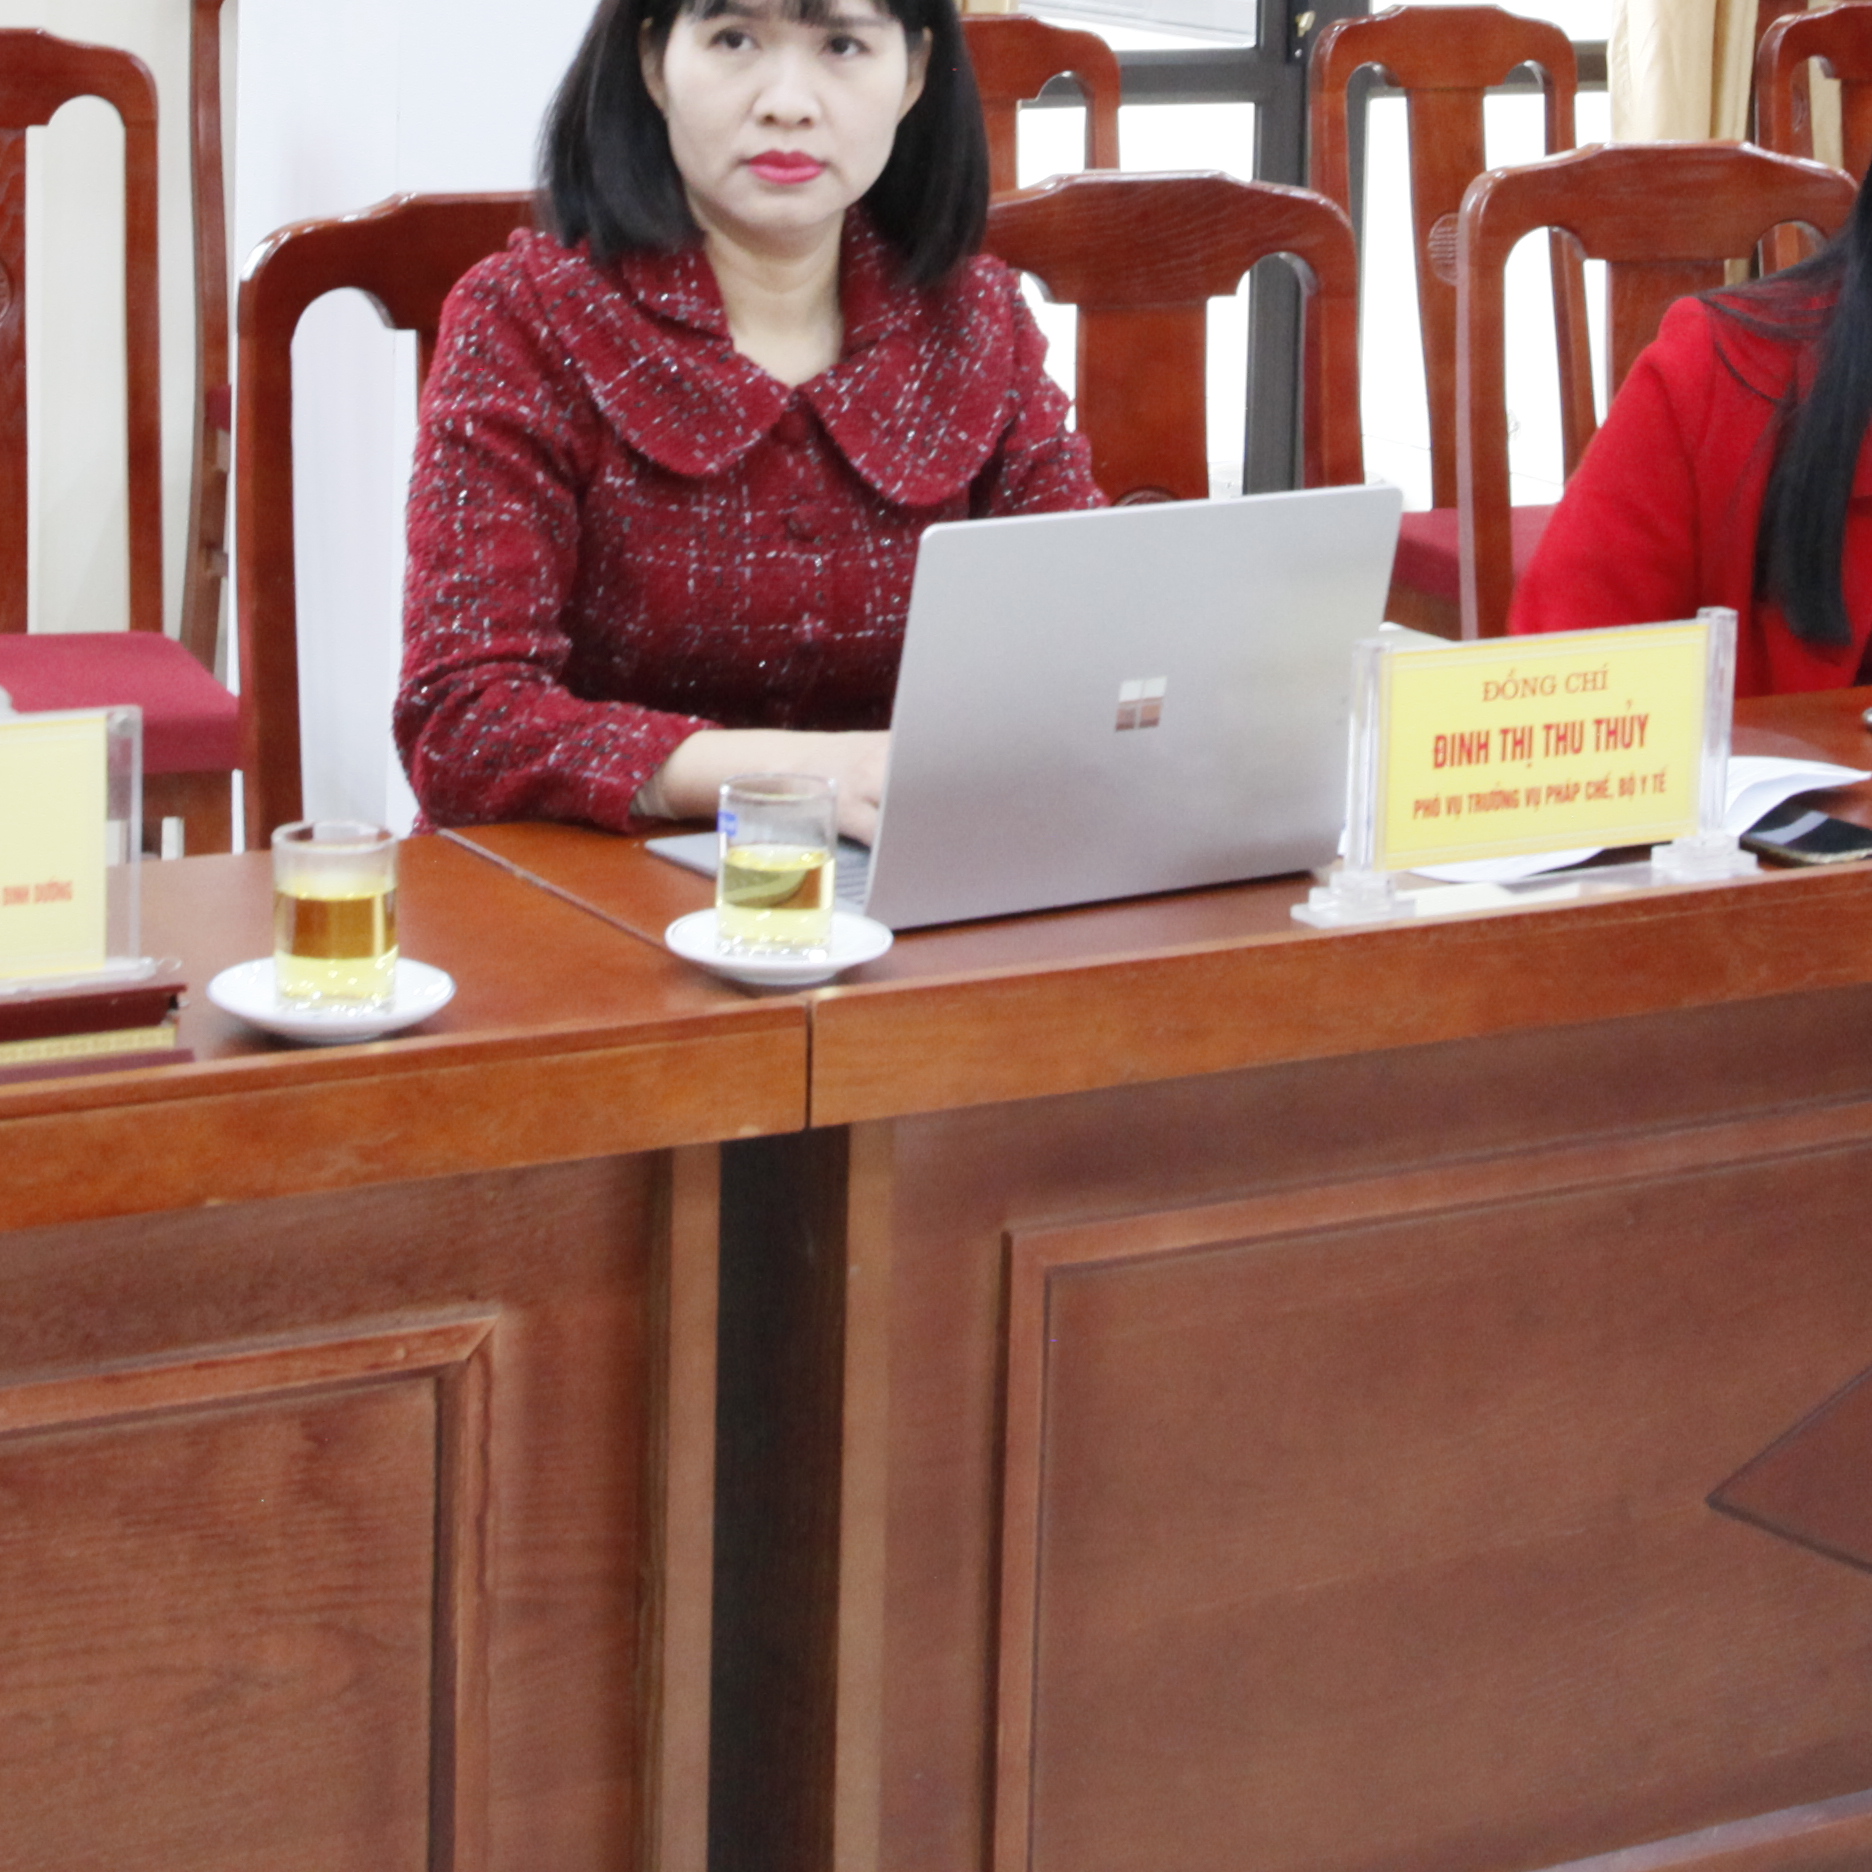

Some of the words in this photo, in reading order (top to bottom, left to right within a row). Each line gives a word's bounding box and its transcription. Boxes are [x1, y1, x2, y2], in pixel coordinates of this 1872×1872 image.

[1565, 662, 1609, 694] CHÍ
[1433, 729, 1490, 769] ĐINH
[1499, 725, 1534, 768] THỊ
[1543, 719, 1584, 758] THU
[1593, 699, 1649, 752] THỦY
